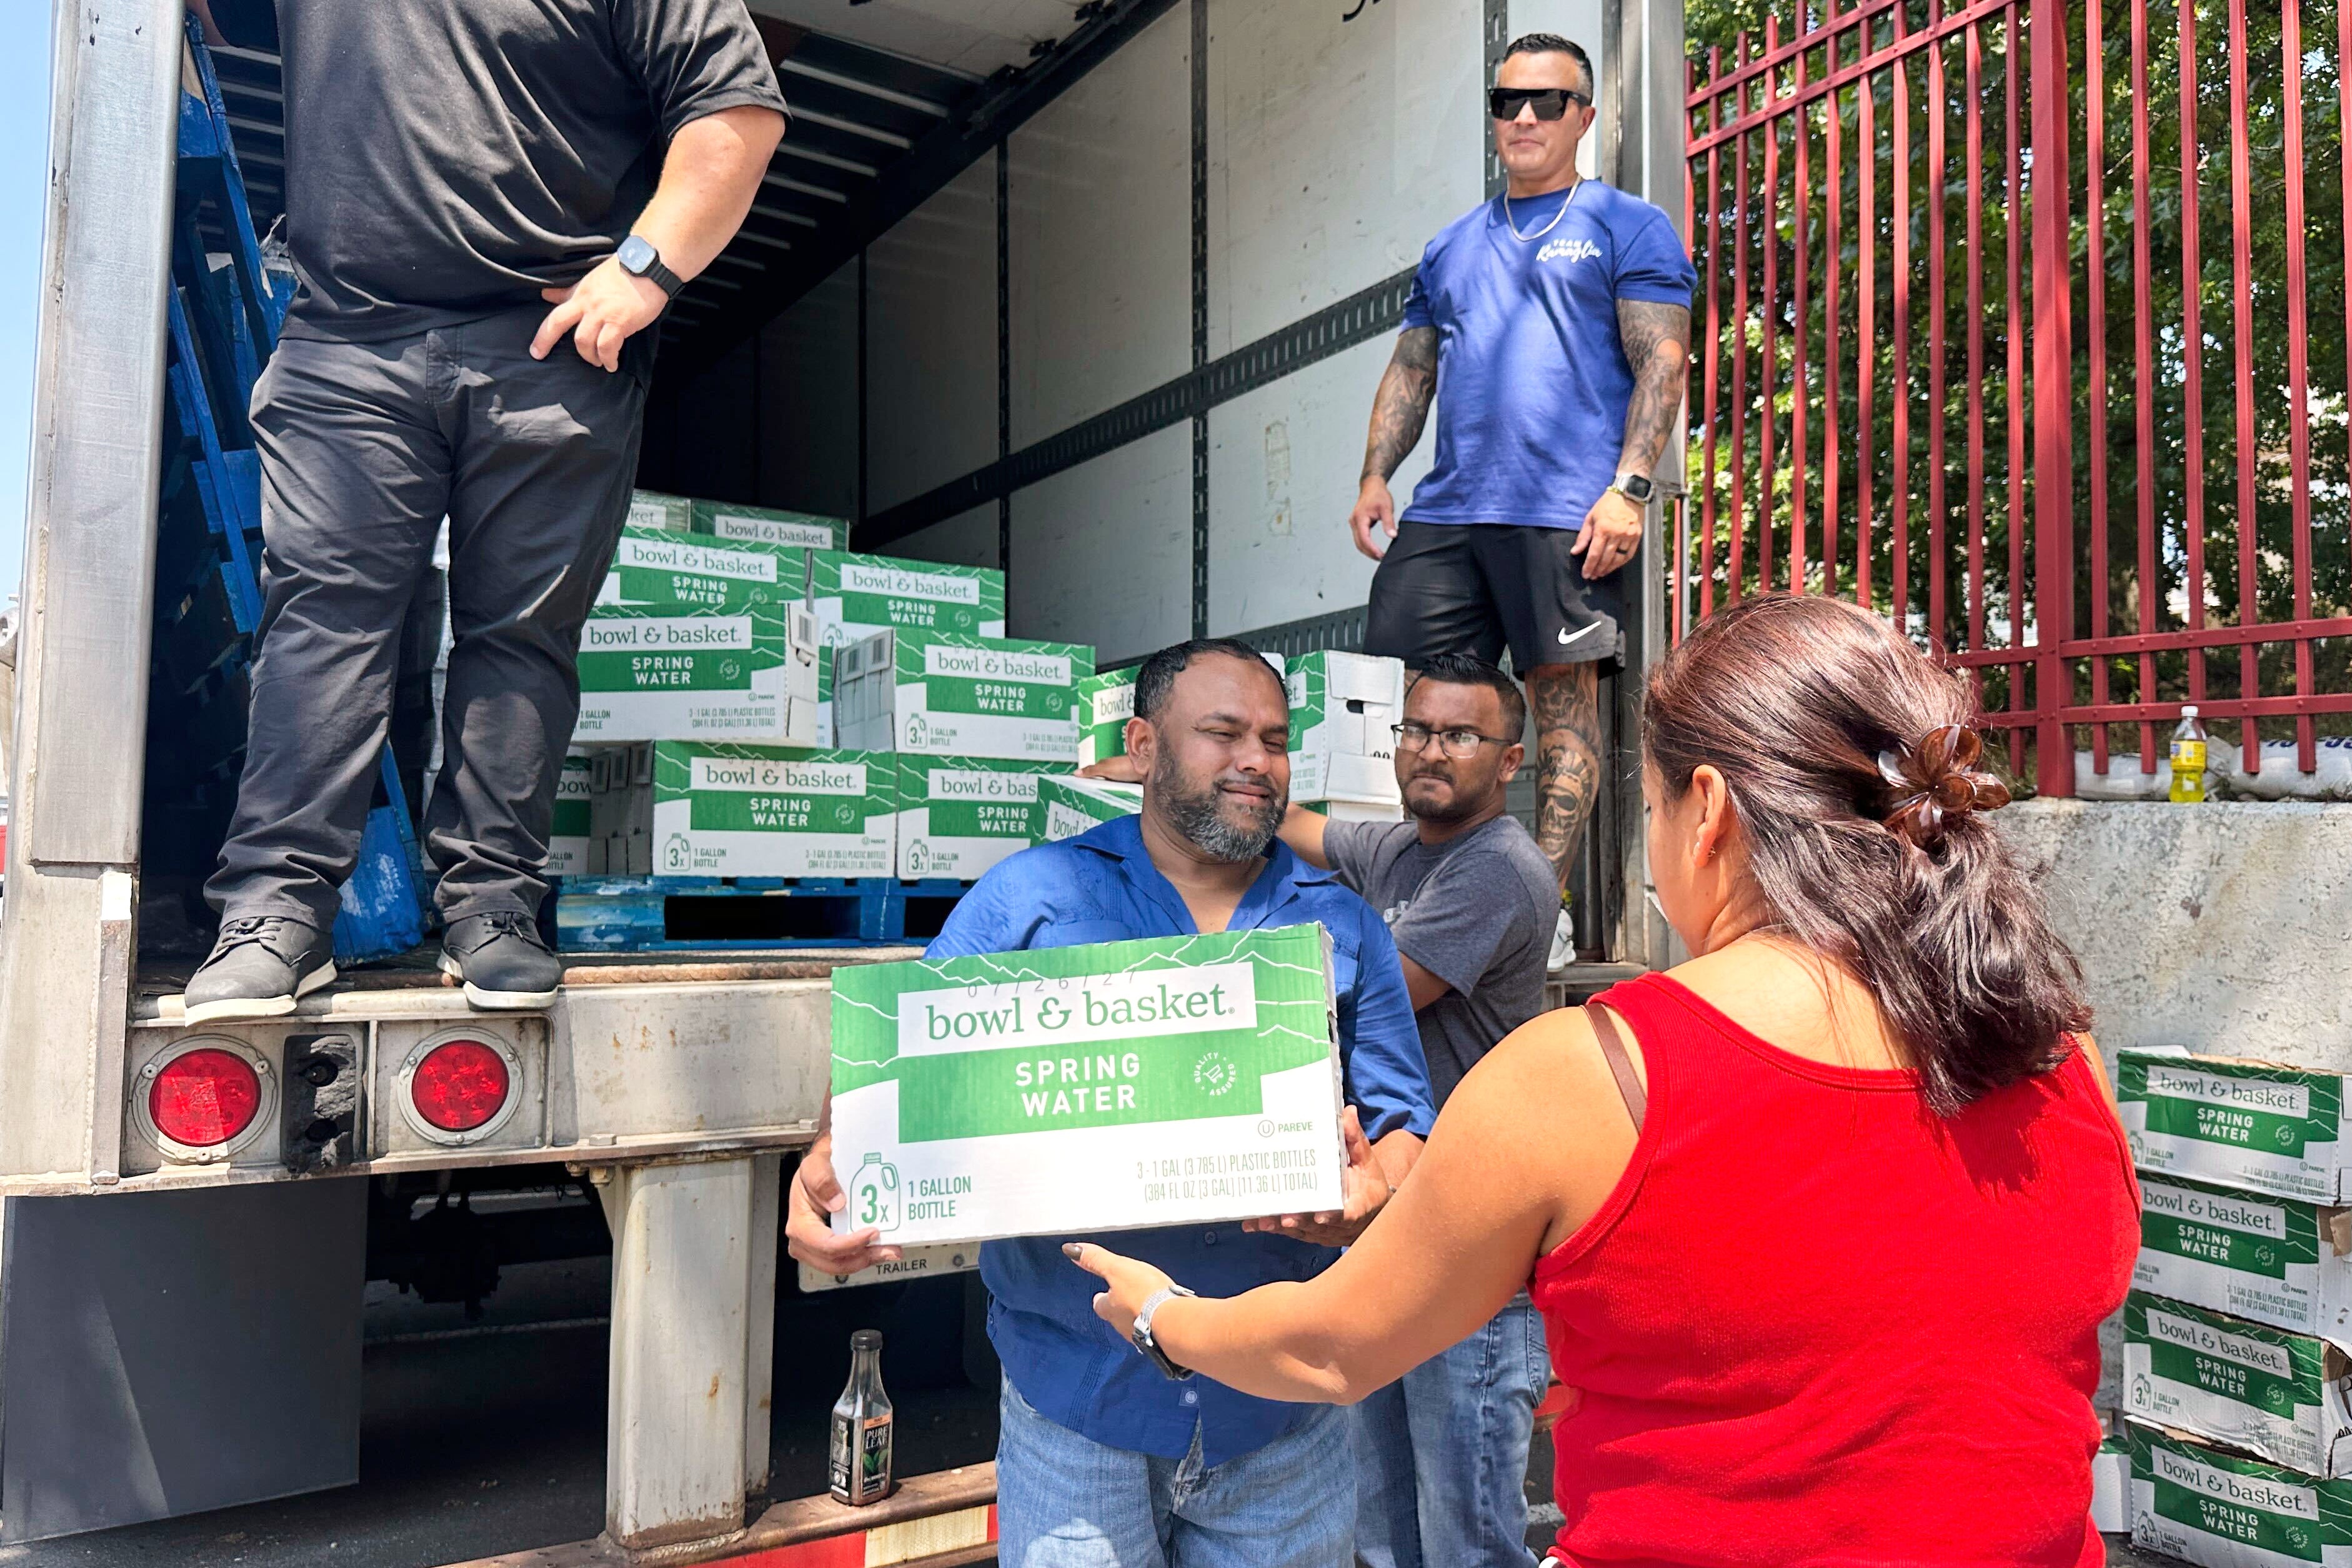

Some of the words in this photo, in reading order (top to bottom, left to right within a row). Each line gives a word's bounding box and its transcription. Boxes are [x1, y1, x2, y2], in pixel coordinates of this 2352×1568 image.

[725, 520, 759, 537] bowl
[764, 527, 775, 538] &
[633, 545, 677, 564] bowl
[683, 552, 698, 567] &
[672, 576, 729, 593] SPRING
[852, 571, 891, 590] bowl
[897, 578, 910, 591] &
[675, 588, 725, 604] WATER
[887, 600, 937, 615] SPRING
[890, 612, 935, 627] WATER
[589, 625, 637, 645] bowl
[644, 627, 661, 643] &
[632, 657, 694, 670] SPRING
[938, 653, 979, 672] bowl
[985, 660, 999, 673] &
[635, 672, 692, 685] WATER
[975, 684, 1026, 698] SPRING
[586, 710, 610, 718] GALLON
[977, 698, 1024, 712] WATER
[1100, 693, 1125, 716] bowl
[580, 720, 603, 730] BOTTLE
[935, 728, 957, 737] GALLON
[930, 737, 950, 746] BOTTLE
[705, 765, 755, 785] bowl
[762, 768, 780, 785] &
[940, 777, 982, 794] bowl
[988, 778, 1003, 795] &
[750, 798, 811, 811] SPRING
[977, 806, 1029, 819] SPRING
[752, 813, 808, 826] WATER
[980, 820, 1026, 832] WATER
[700, 848, 727, 857] GALLON
[937, 853, 959, 861] GALLON
[694, 858, 719, 868] BOTTLE
[931, 862, 952, 871] BOTTLE
[926, 996, 1025, 1040] bowl
[1037, 996, 1072, 1030] &
[1015, 1053, 1140, 1086] SPRING
[1193, 1052, 1218, 1083] QUALITY
[1209, 1063, 1236, 1096] ASSURED
[2161, 1072, 2205, 1095] bowl
[2210, 1081, 2226, 1097] &
[1020, 1084, 1136, 1118] WATER
[1278, 1121, 1313, 1133] PAREVE
[2196, 1107, 2254, 1128] SPRING
[2198, 1122, 2250, 1143] WATER
[1137, 1161, 1143, 1179] 3
[1162, 1159, 1180, 1178] GAL
[1230, 1152, 1270, 1172] PLASTIC
[1273, 1148, 1316, 1169] BOTTLES
[909, 1181, 914, 1197] 1
[920, 1176, 972, 1196] GALLON
[1144, 1183, 1165, 1204] (384
[1169, 1182, 1179, 1199] FL
[1183, 1181, 1195, 1199] OZ
[1212, 1178, 1235, 1198] GAL]
[1283, 1171, 1318, 1191] TOTAL)
[909, 1200, 956, 1220] BOTTLE
[2144, 1188, 2183, 1212] bowl
[2188, 1198, 2203, 1214] &
[2178, 1224, 2231, 1248] SPRING
[2179, 1239, 2230, 1261] WATER
[876, 1258, 927, 1275] TRAILER
[2158, 1317, 2197, 1344] bowl
[2201, 1332, 2215, 1349] &
[2195, 1357, 2246, 1382] SPRING
[2198, 1371, 2246, 1397] WATER
[865, 1436, 886, 1449] LEAF
[867, 1426, 887, 1439] PURE
[2161, 1456, 2200, 1486] bowl
[2207, 1474, 2223, 1491] &
[2199, 1499, 2258, 1526] SPRING
[2203, 1514, 2258, 1541] WATER
